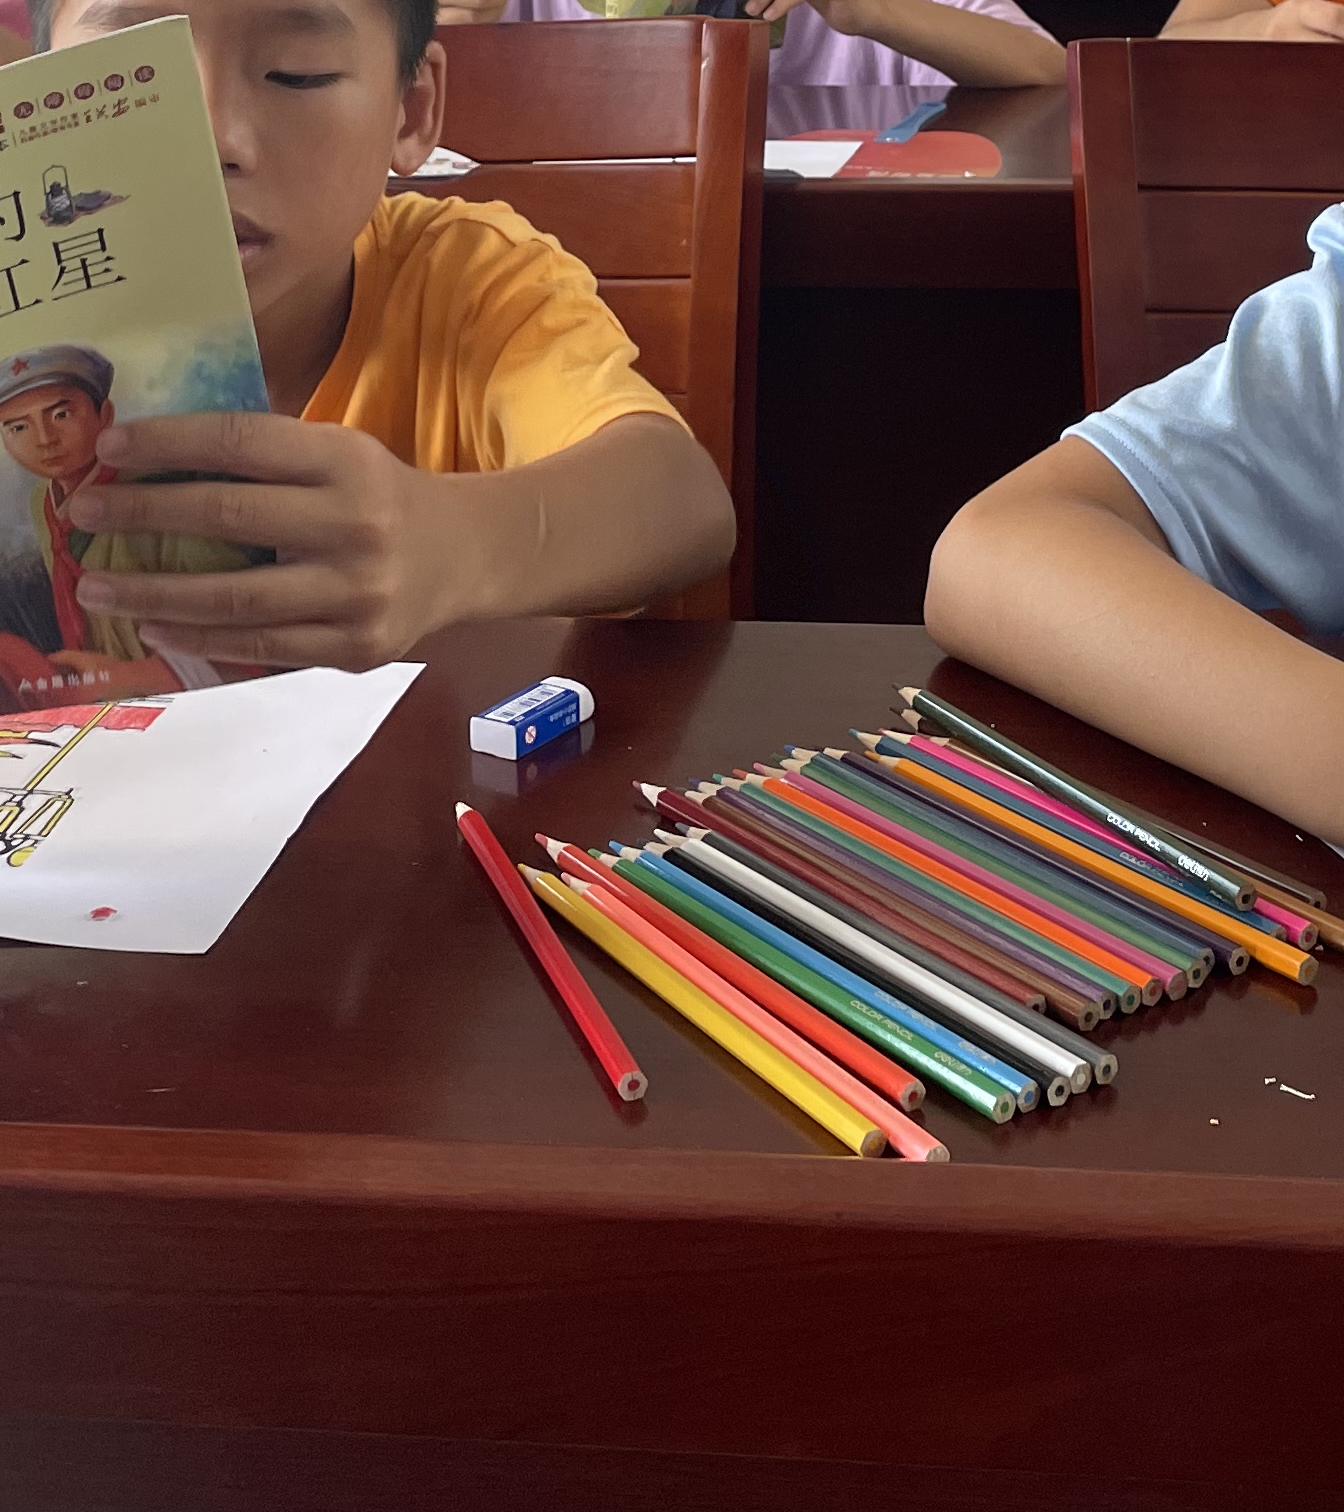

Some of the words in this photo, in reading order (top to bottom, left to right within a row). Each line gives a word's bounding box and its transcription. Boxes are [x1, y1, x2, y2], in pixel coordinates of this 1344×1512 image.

[1106, 811, 1136, 835] COLOR
[1136, 827, 1161, 852] PENCIL
[849, 999, 883, 1022] COLOR
[882, 1015, 915, 1042] PENCIL
